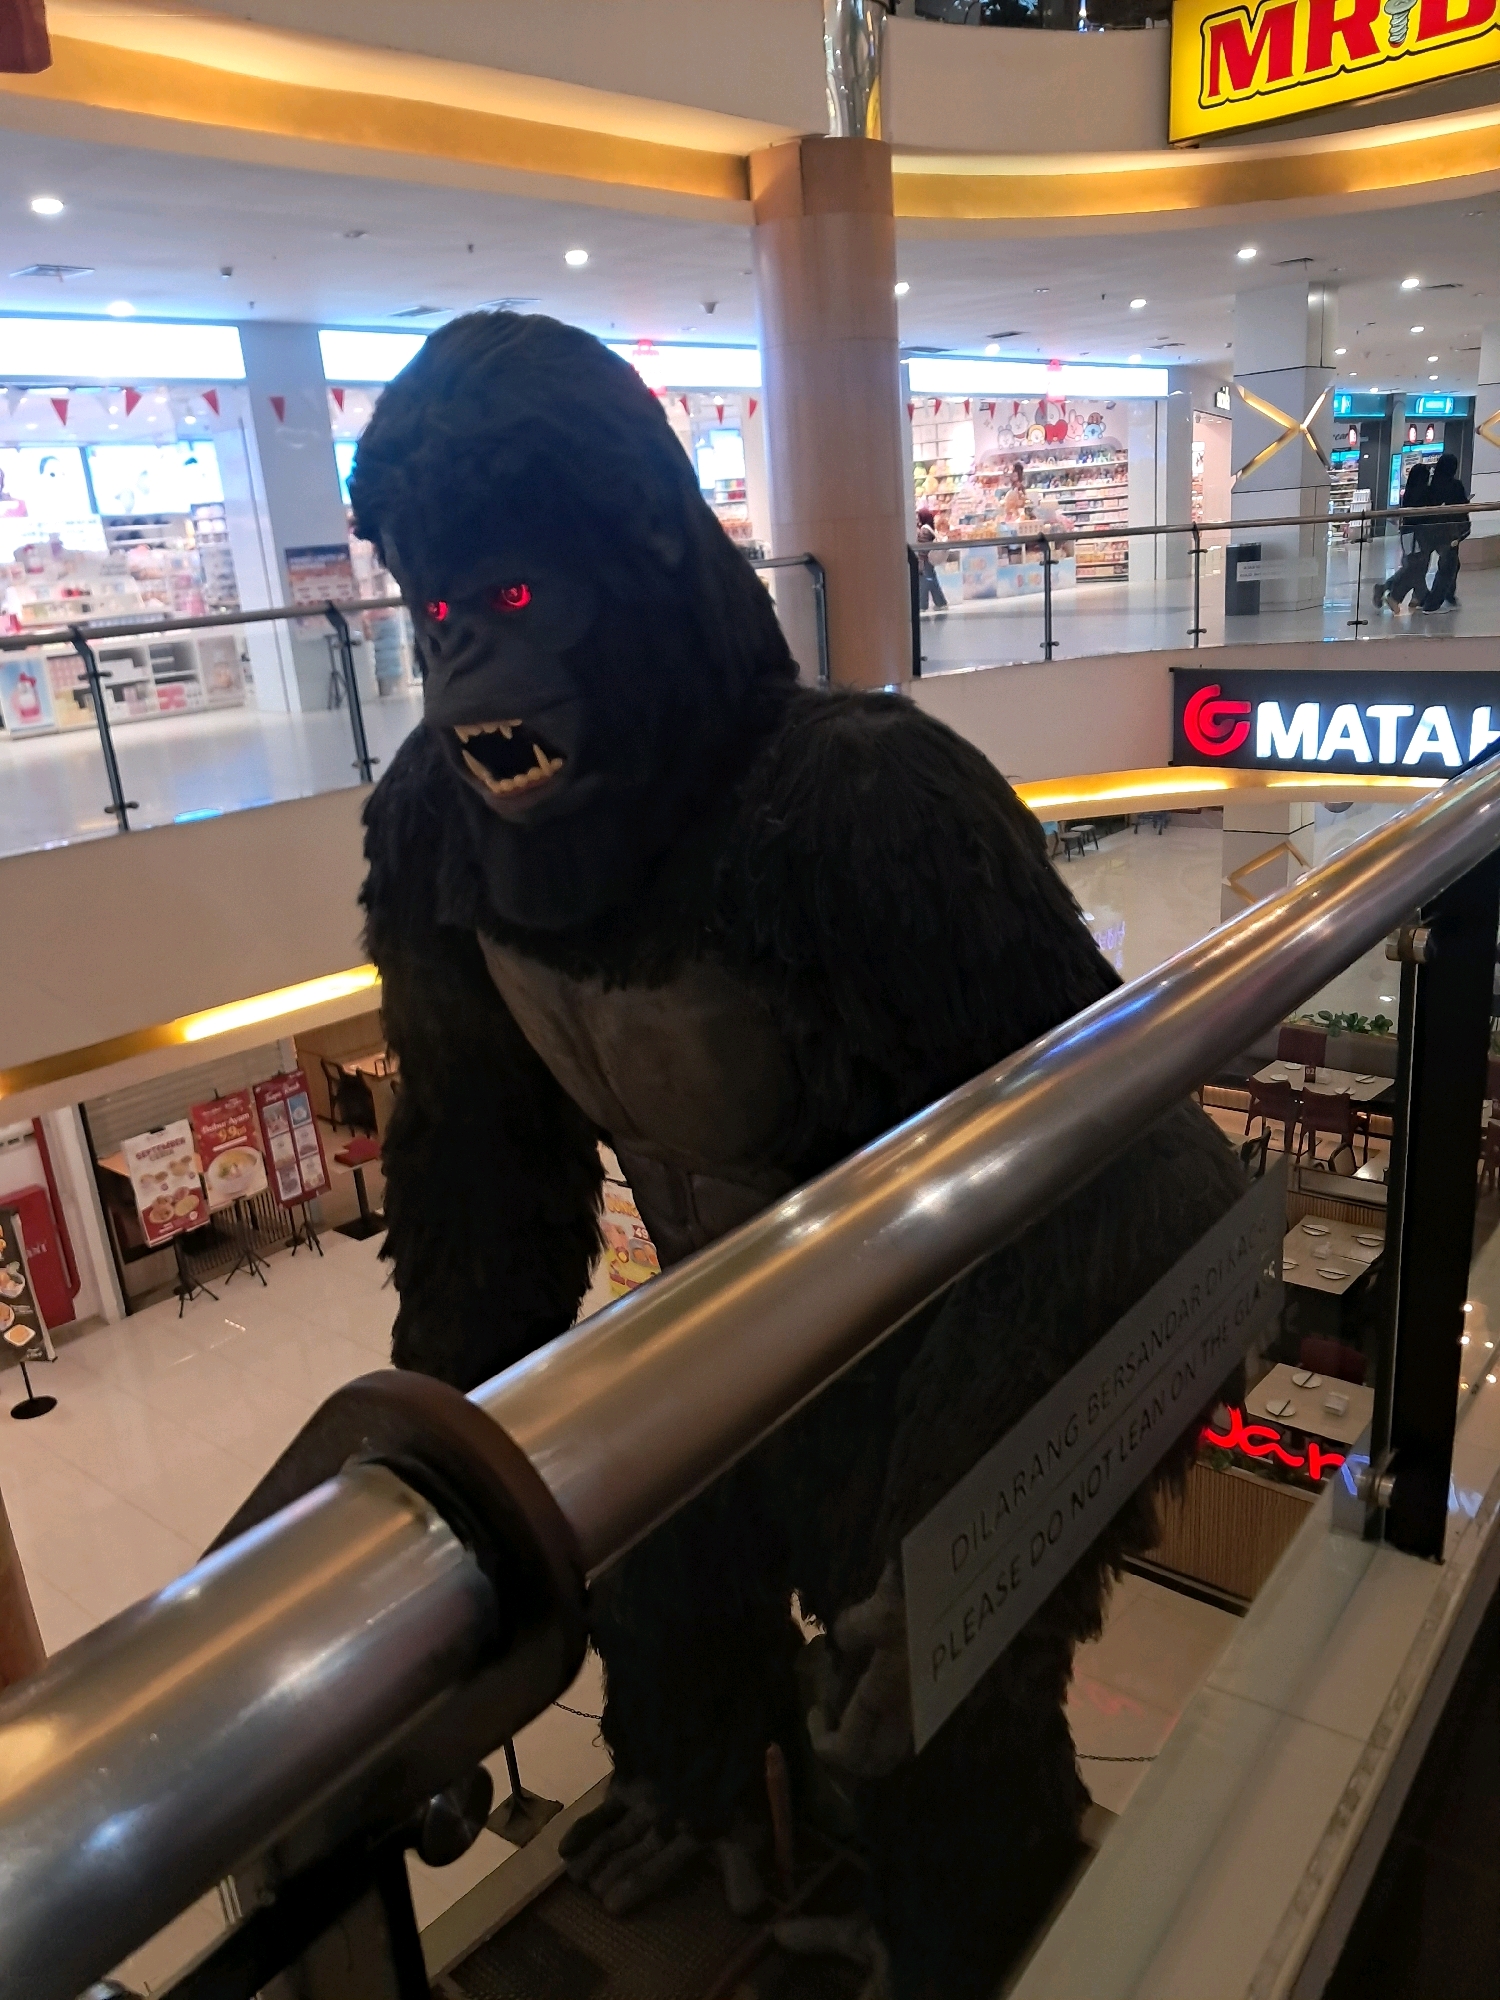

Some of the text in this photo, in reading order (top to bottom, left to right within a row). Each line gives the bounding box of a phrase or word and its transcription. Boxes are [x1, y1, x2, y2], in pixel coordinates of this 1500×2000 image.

[931, 1559, 1022, 1683] PLEASE
[1029, 1515, 1064, 1571] DO
[1071, 1453, 1115, 1520] NOT
[1119, 1395, 1166, 1464] LEAN
[1170, 1361, 1197, 1401] ON
[1200, 1323, 1231, 1369] THE
[949, 1411, 1080, 1575] DILARANG
[1086, 1284, 1203, 1425] BERSANDAR
[1205, 1259, 1226, 1301] DI
